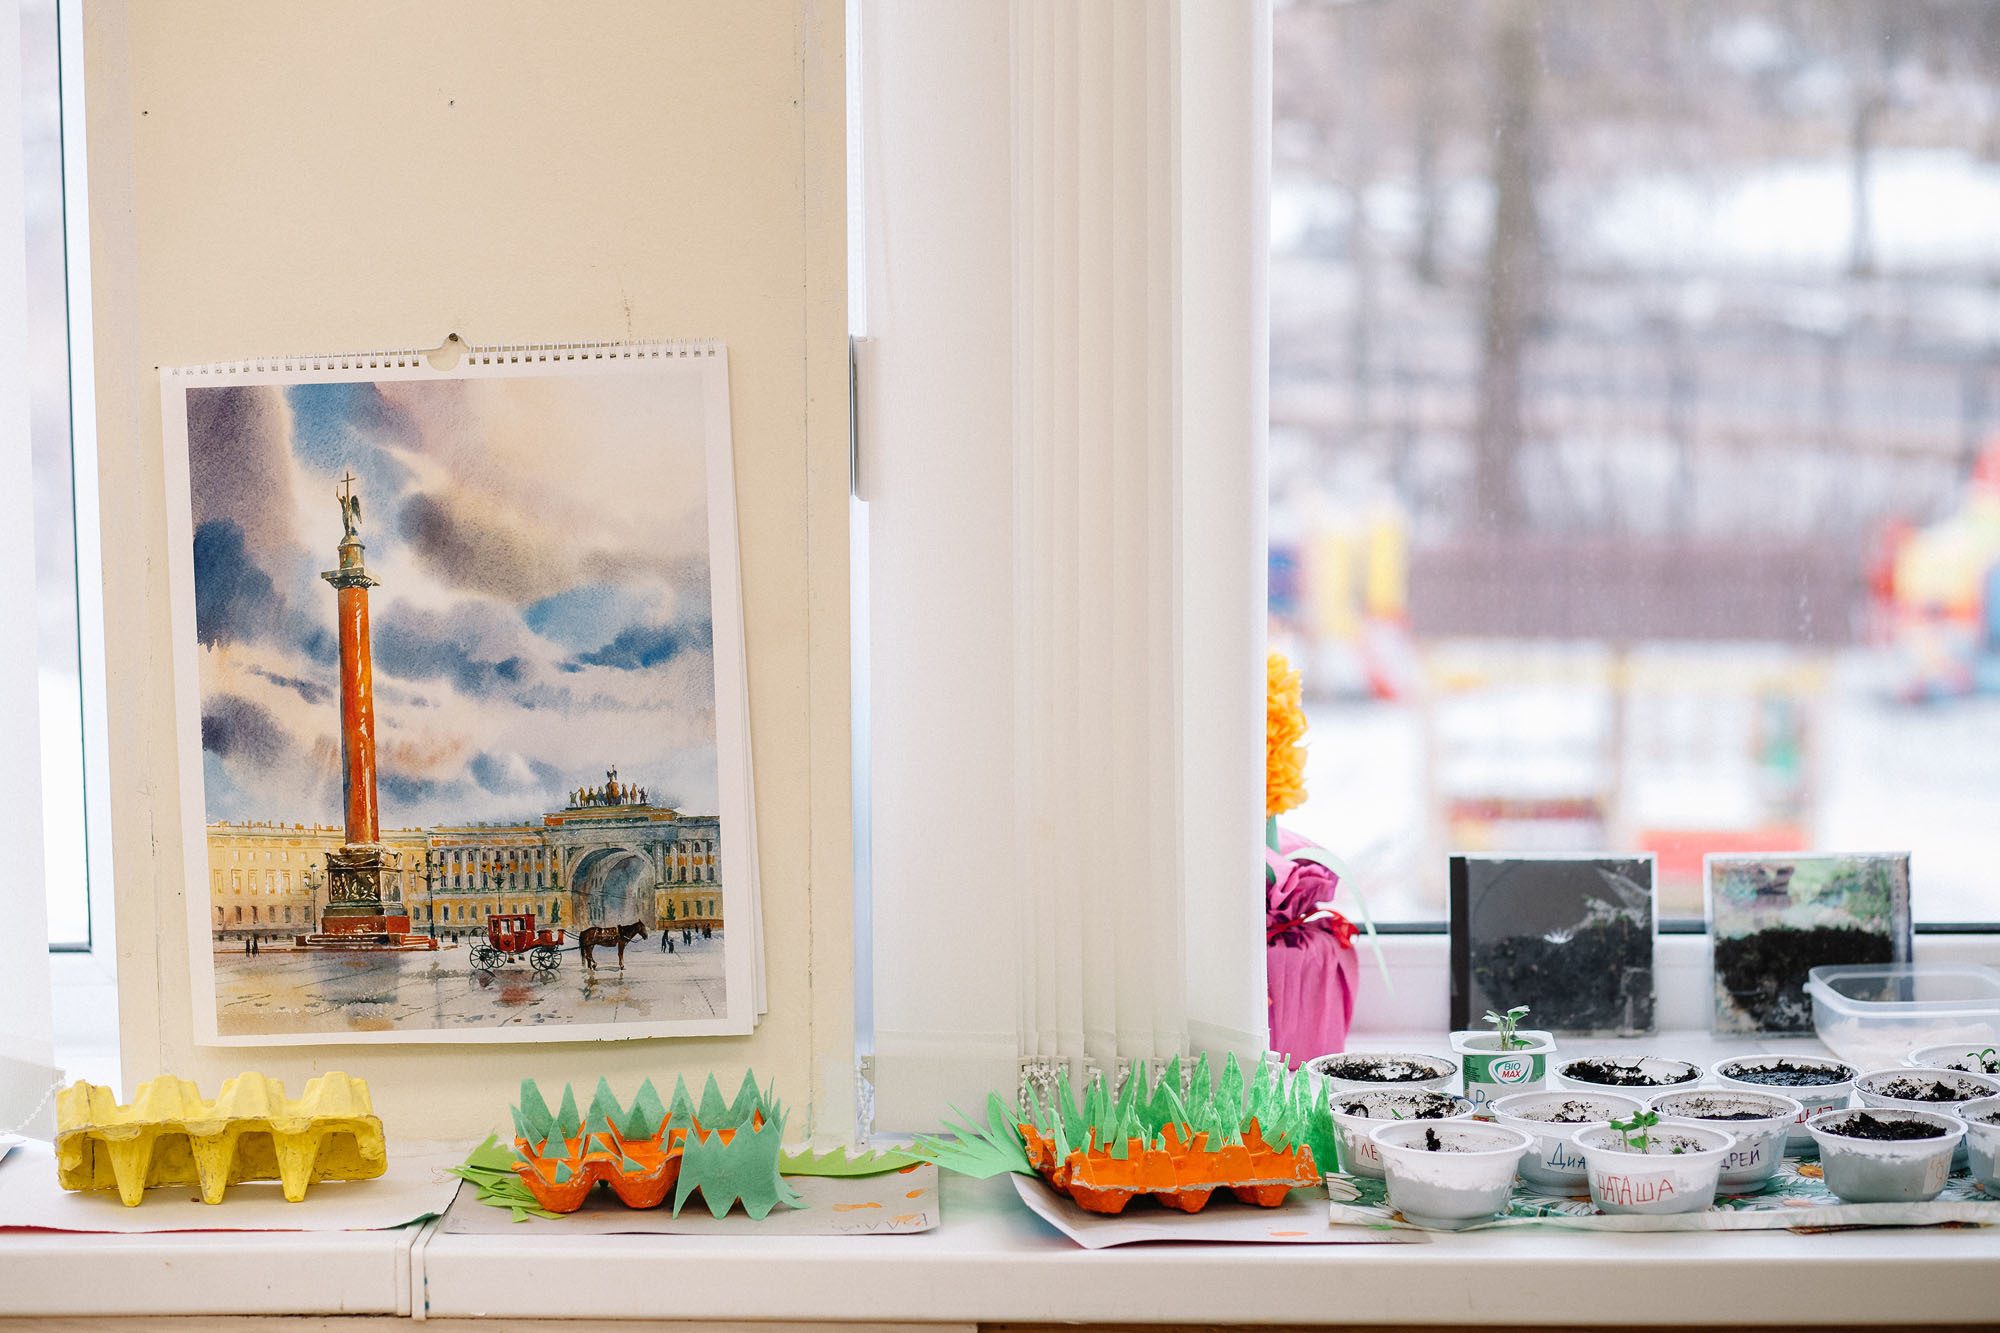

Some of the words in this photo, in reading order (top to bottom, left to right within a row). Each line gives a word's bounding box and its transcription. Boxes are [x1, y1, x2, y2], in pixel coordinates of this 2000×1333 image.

[1503, 1062, 1521, 1071] BIO
[1501, 1070, 1521, 1078] MAX
[1597, 1174, 1674, 1205] НАТАША
